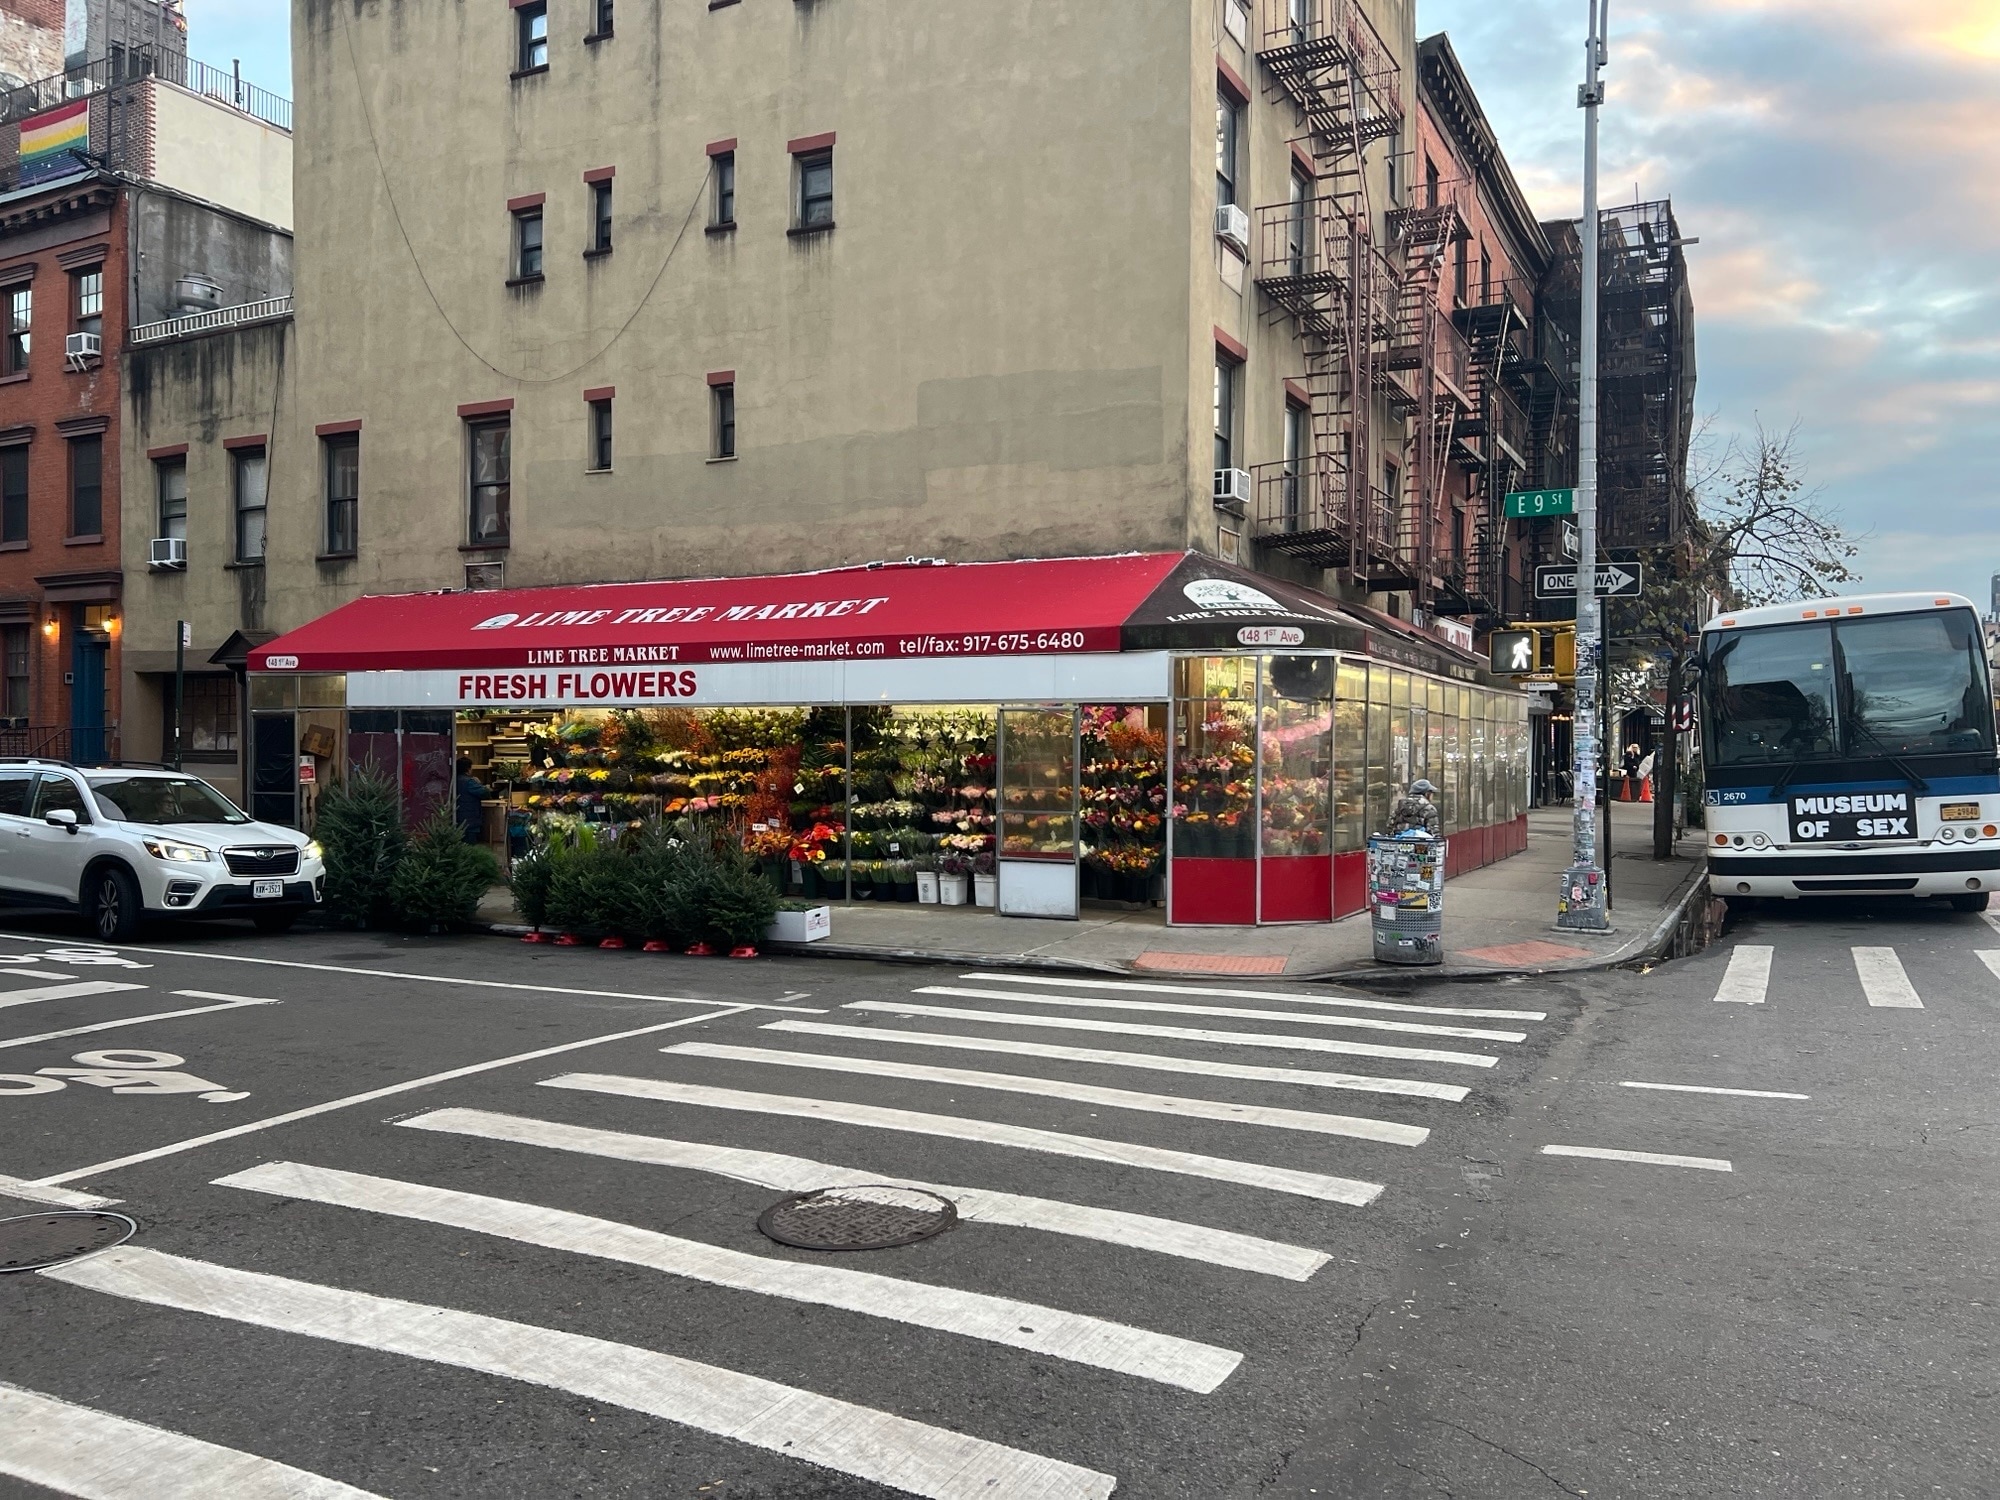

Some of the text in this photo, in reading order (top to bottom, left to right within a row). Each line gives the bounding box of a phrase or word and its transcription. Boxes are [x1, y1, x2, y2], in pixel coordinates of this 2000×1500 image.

[1518, 492, 1563, 514] E 9 St
[1547, 573, 1622, 588] ONE WAY
[513, 597, 890, 628] LIME TREE MARKET
[1166, 611, 1214, 623] LIME
[1216, 609, 1267, 617] TREE
[899, 637, 960, 654] tel/fax:
[962, 631, 1085, 651] 917-675-6480
[1240, 630, 1260, 642] 148
[528, 646, 680, 664] LIME TREE MARKET
[458, 670, 697, 699] FRESH FLOWERS
[1723, 792, 1746, 801] 2670
[1795, 794, 1907, 815] MUSEUM
[1796, 817, 1909, 838] OF SEX
